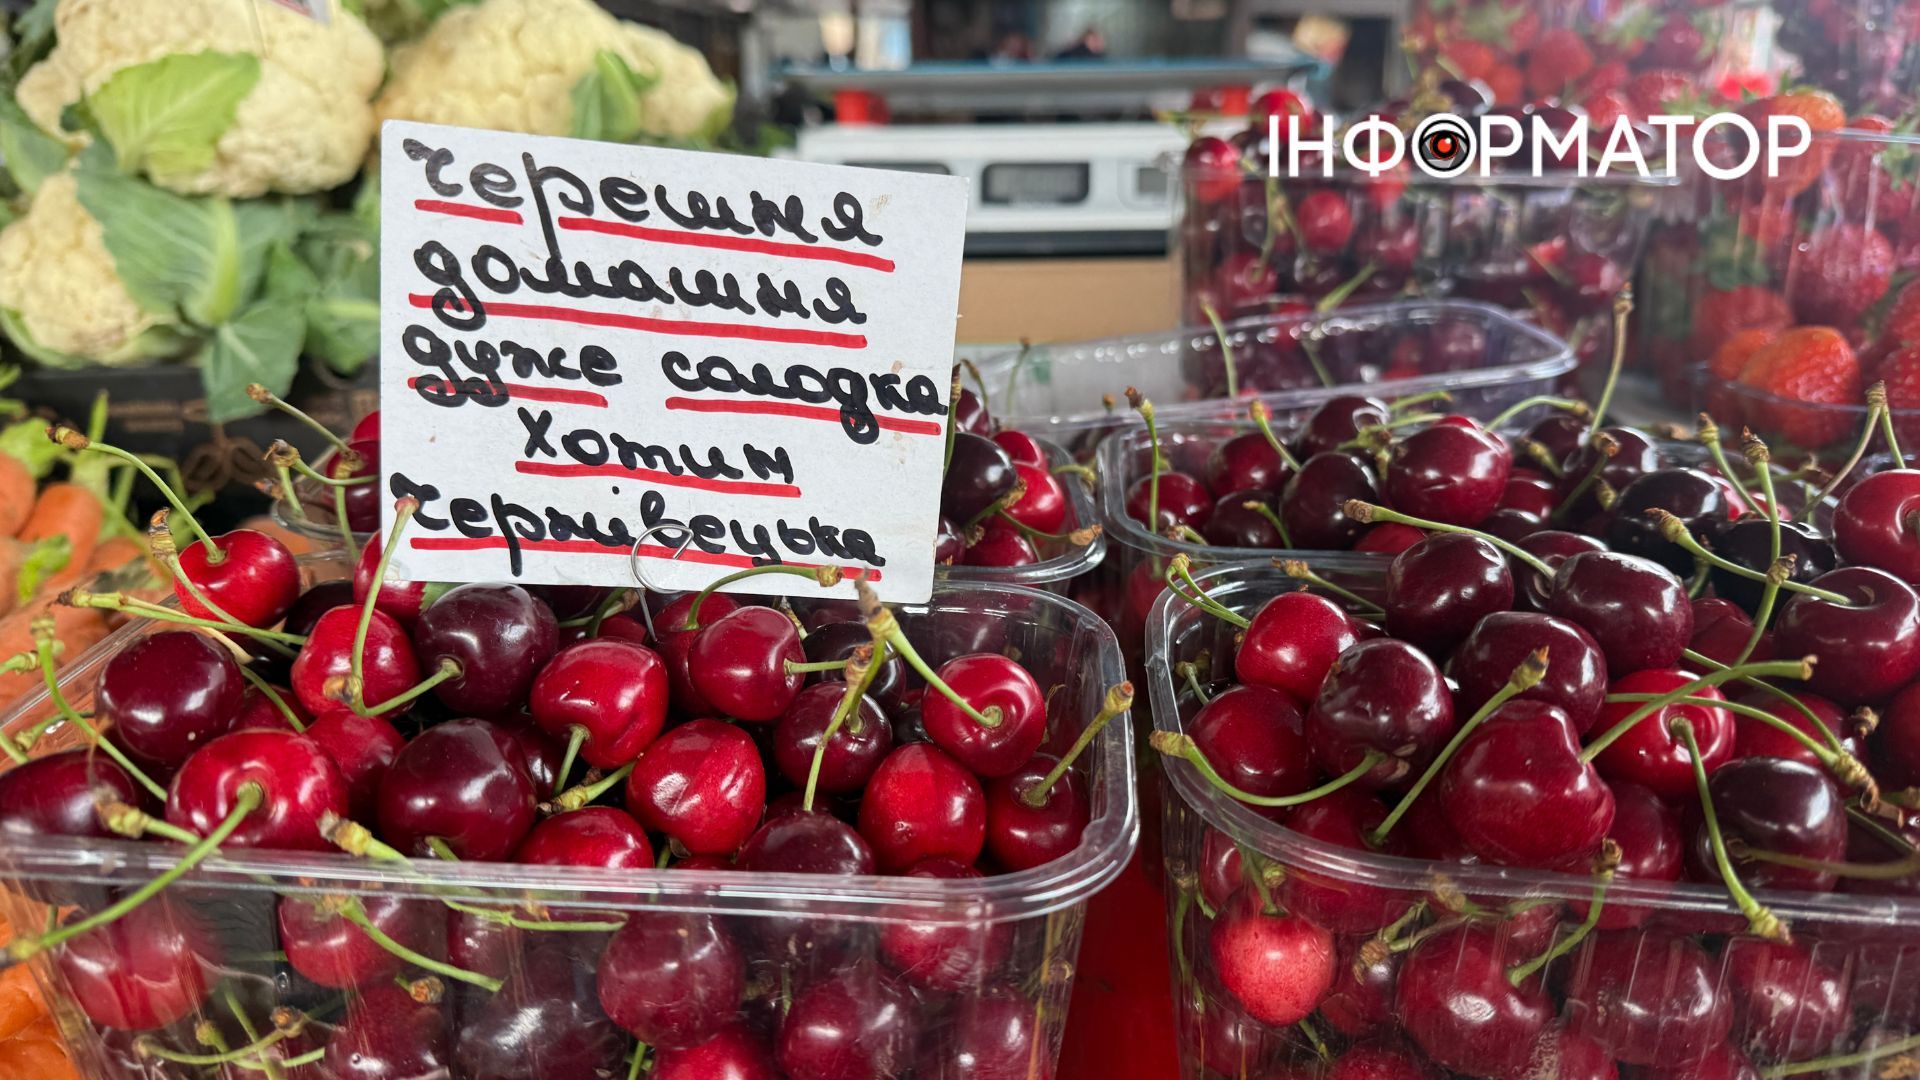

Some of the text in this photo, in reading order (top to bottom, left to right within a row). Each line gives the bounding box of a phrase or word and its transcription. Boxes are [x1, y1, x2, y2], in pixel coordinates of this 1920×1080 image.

[413, 240, 868, 332] домашня
[402, 324, 949, 445] дуже солодка
